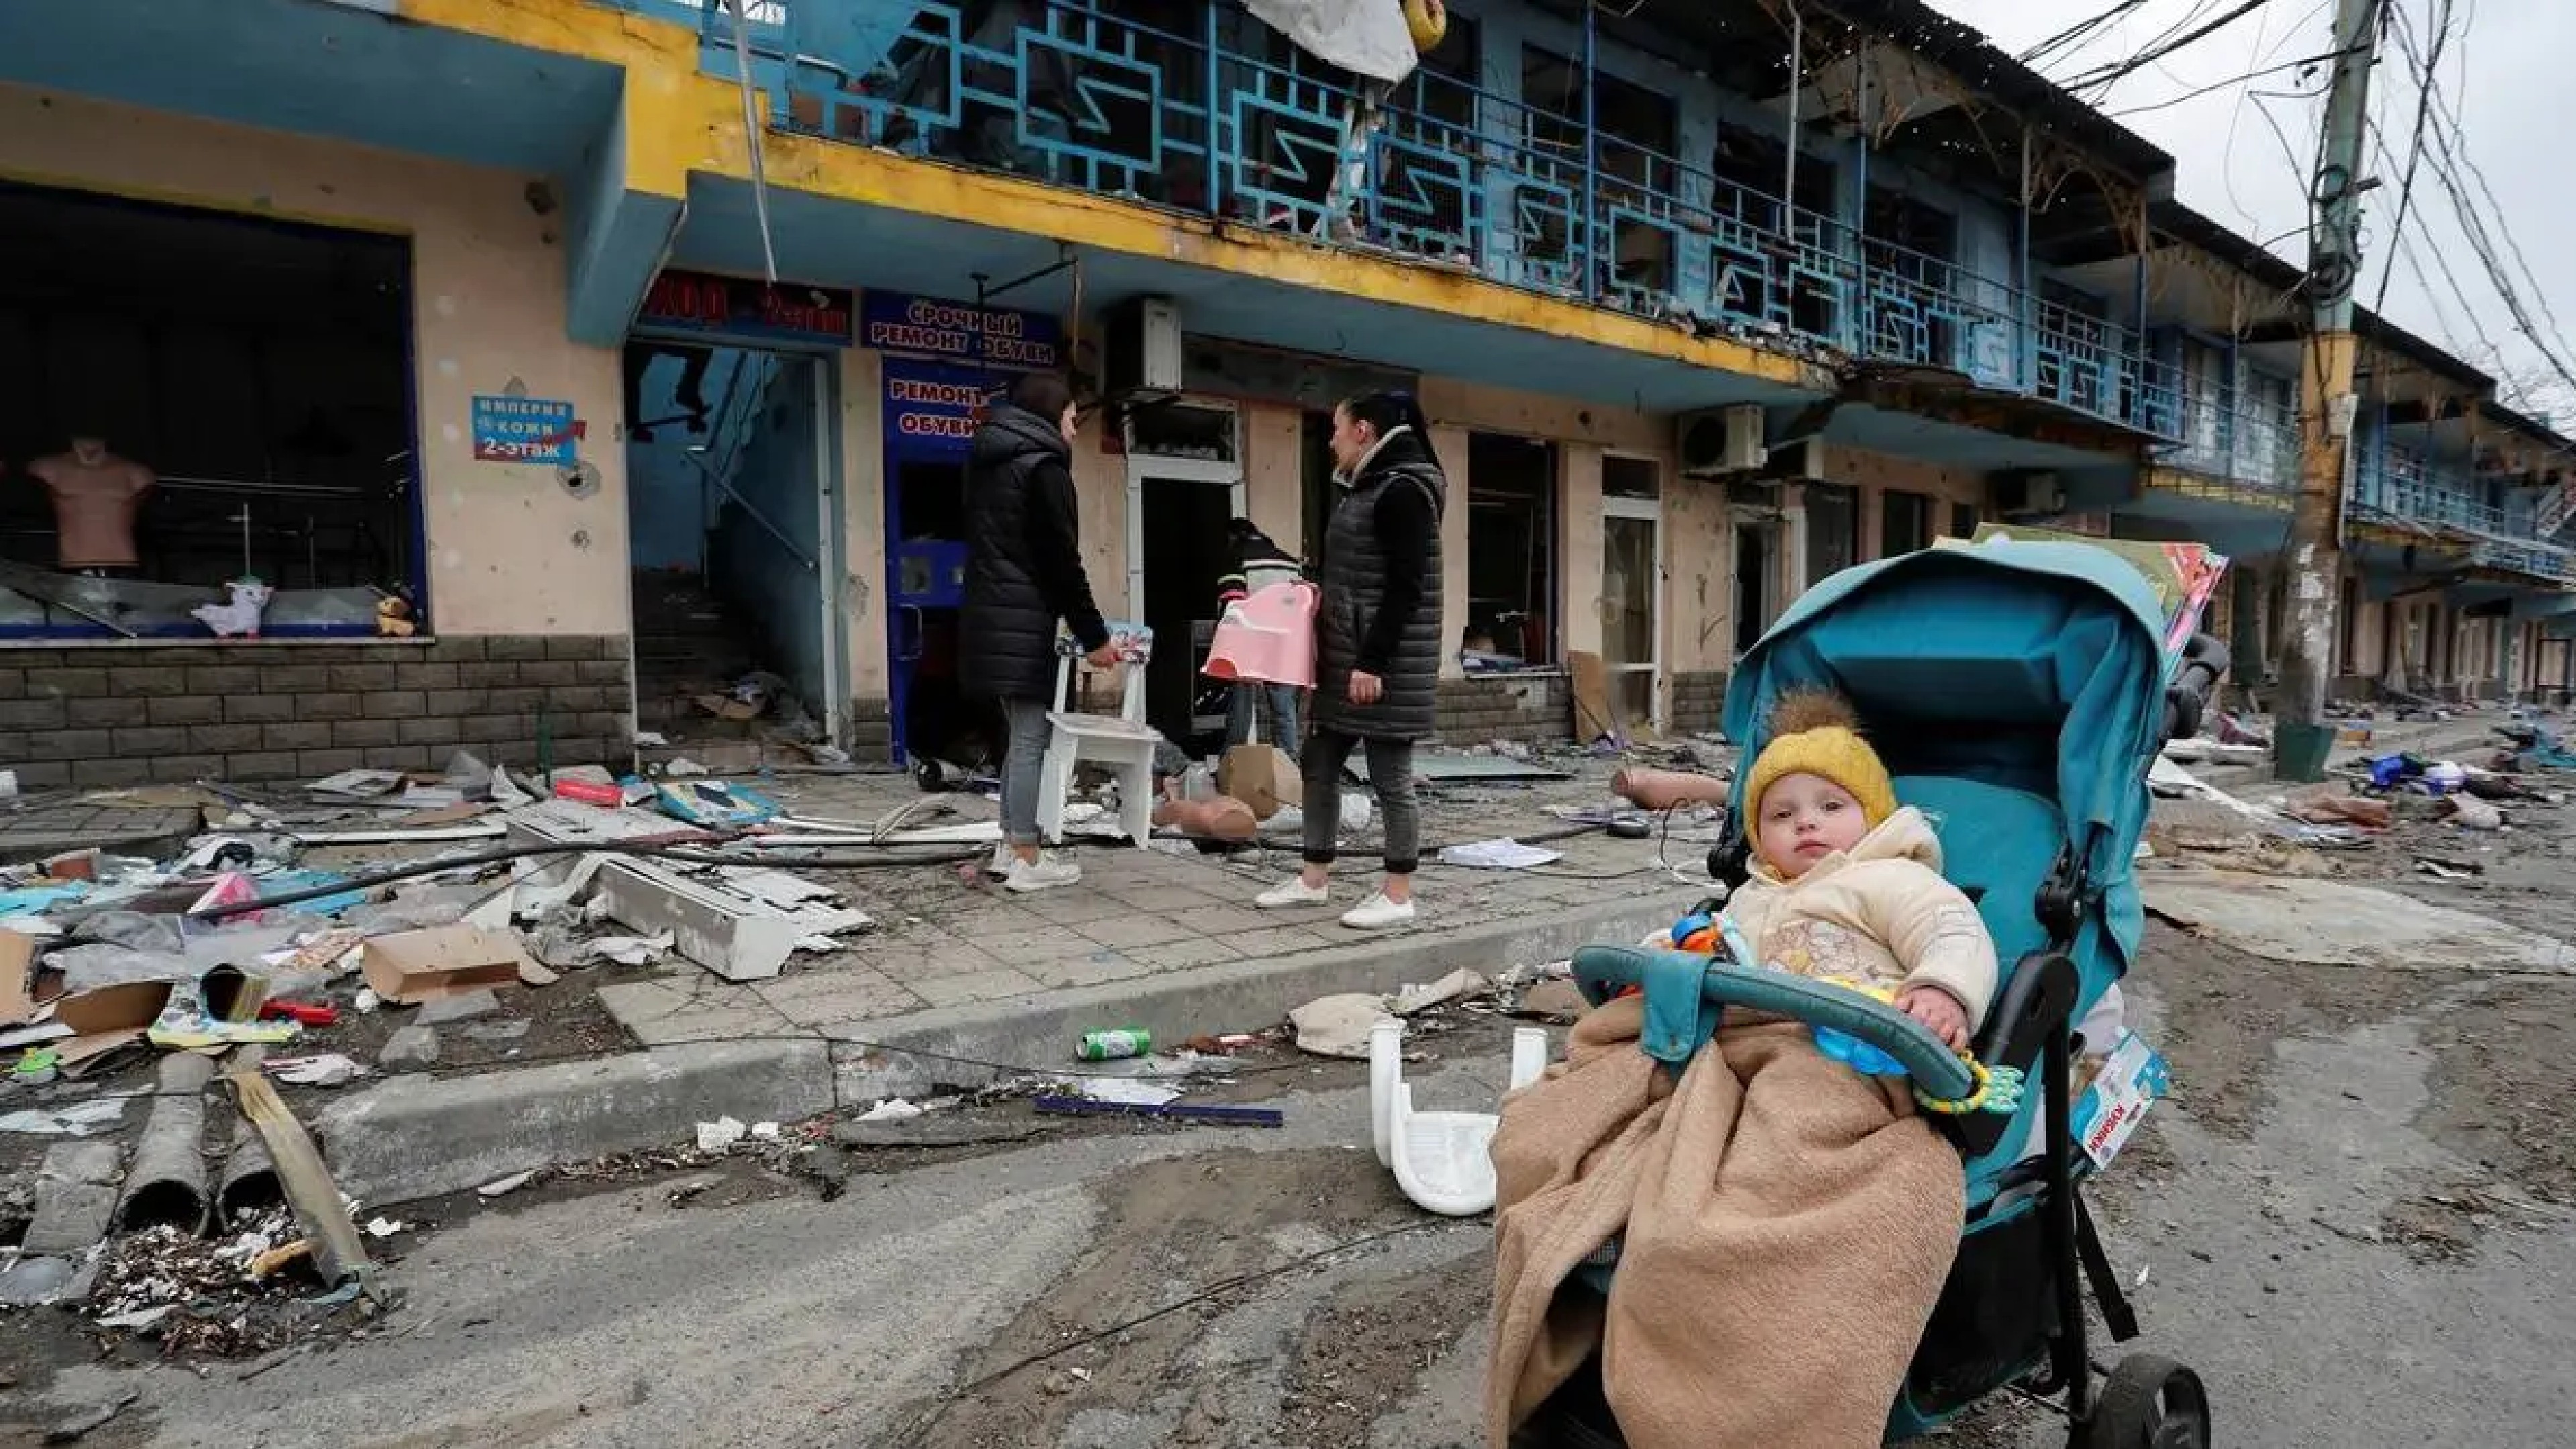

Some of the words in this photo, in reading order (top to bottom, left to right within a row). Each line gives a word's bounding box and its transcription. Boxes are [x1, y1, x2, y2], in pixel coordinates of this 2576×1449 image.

[908, 299, 1022, 337] СРОЧНЫЙ
[871, 322, 969, 354] РЕМОНТ
[889, 378, 985, 407] РЕМОНТ
[480, 399, 566, 416] ИМПЕРИЯ
[497, 421, 553, 435] КОЖИ
